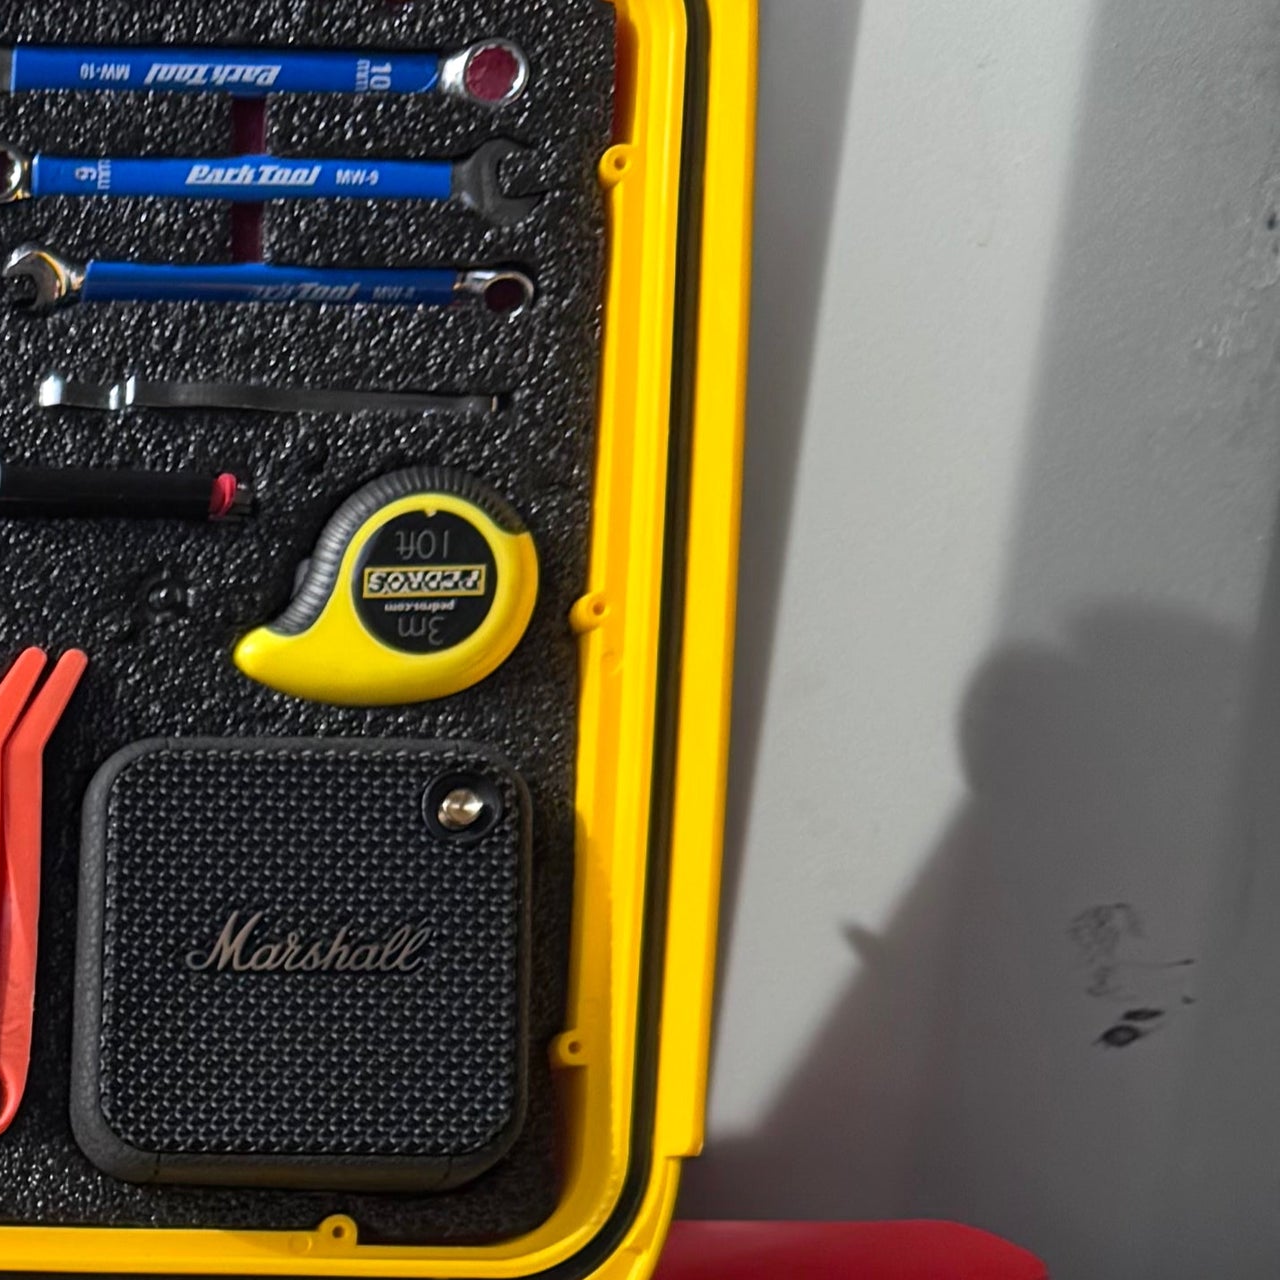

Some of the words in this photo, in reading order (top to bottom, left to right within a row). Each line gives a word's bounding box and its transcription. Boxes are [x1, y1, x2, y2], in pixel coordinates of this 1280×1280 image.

[80, 62, 130, 80] MW-10
[143, 62, 213, 86] Tool
[208, 63, 282, 86] Park
[371, 62, 393, 90] 10
[75, 164, 98, 182] 9
[185, 164, 258, 187] Park
[256, 165, 322, 186] Tool
[335, 169, 380, 186] MW-9
[297, 282, 361, 301] Tool
[395, 529, 450, 560] 10ft
[397, 616, 445, 646] 3m
[184, 908, 434, 975] Marshall
